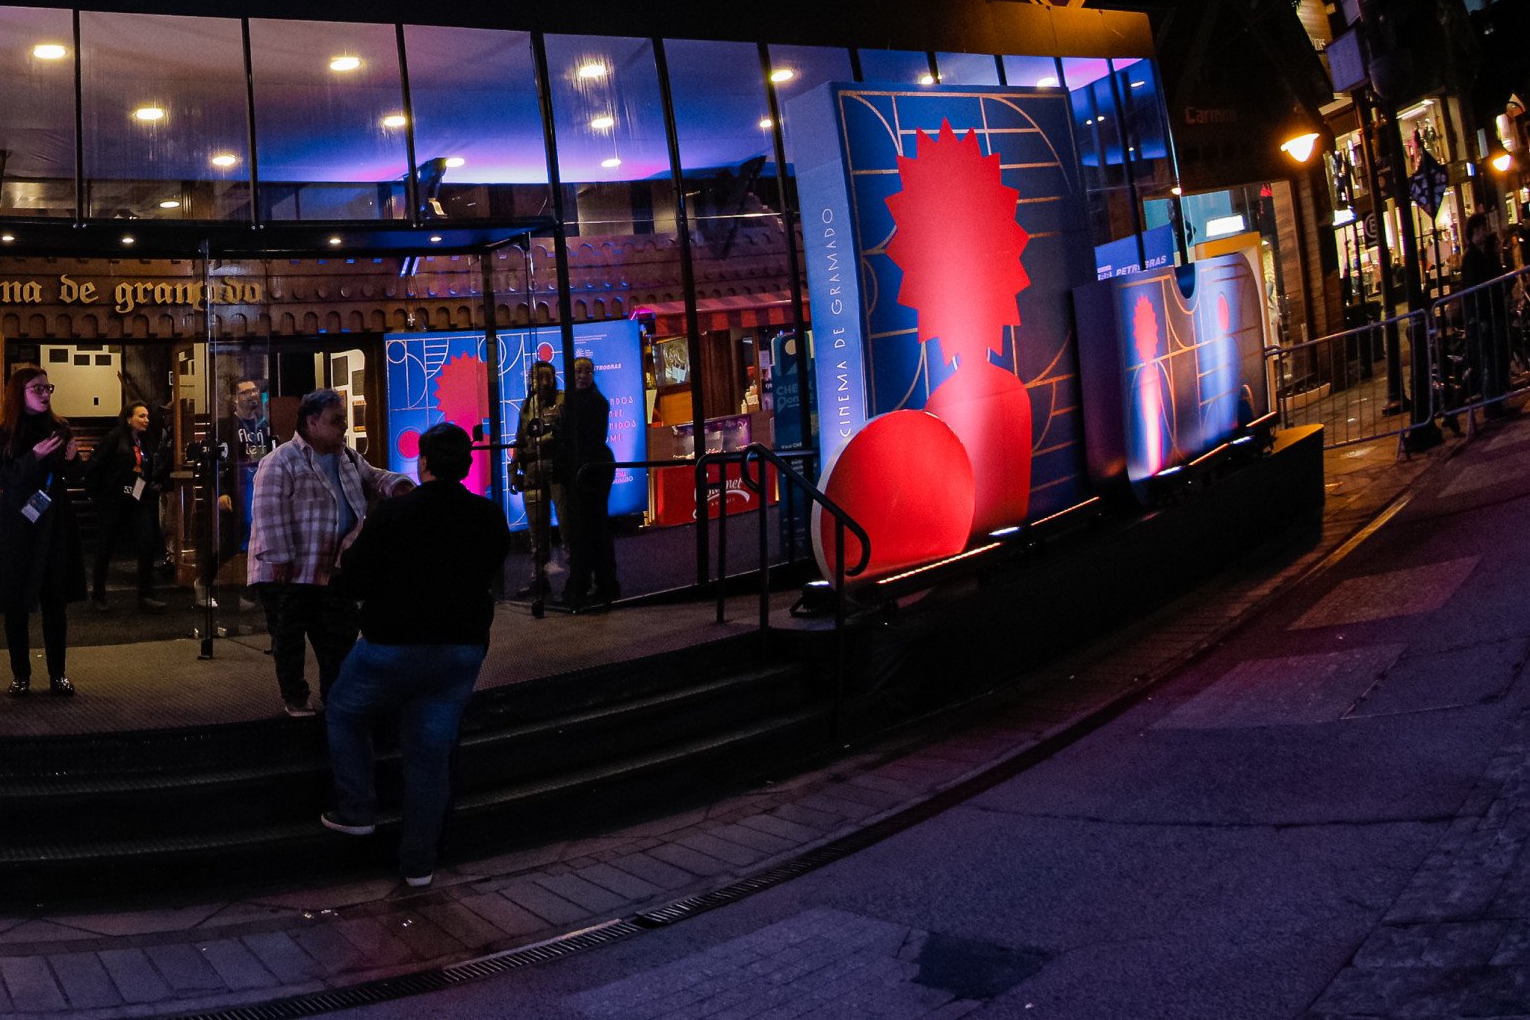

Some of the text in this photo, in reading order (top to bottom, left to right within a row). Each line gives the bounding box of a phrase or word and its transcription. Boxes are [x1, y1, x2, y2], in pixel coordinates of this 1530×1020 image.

[1116, 254, 1167, 277] PETRBRAS
[59, 273, 99, 304] de
[821, 208, 852, 437] CINEMA DE GRAMADO
